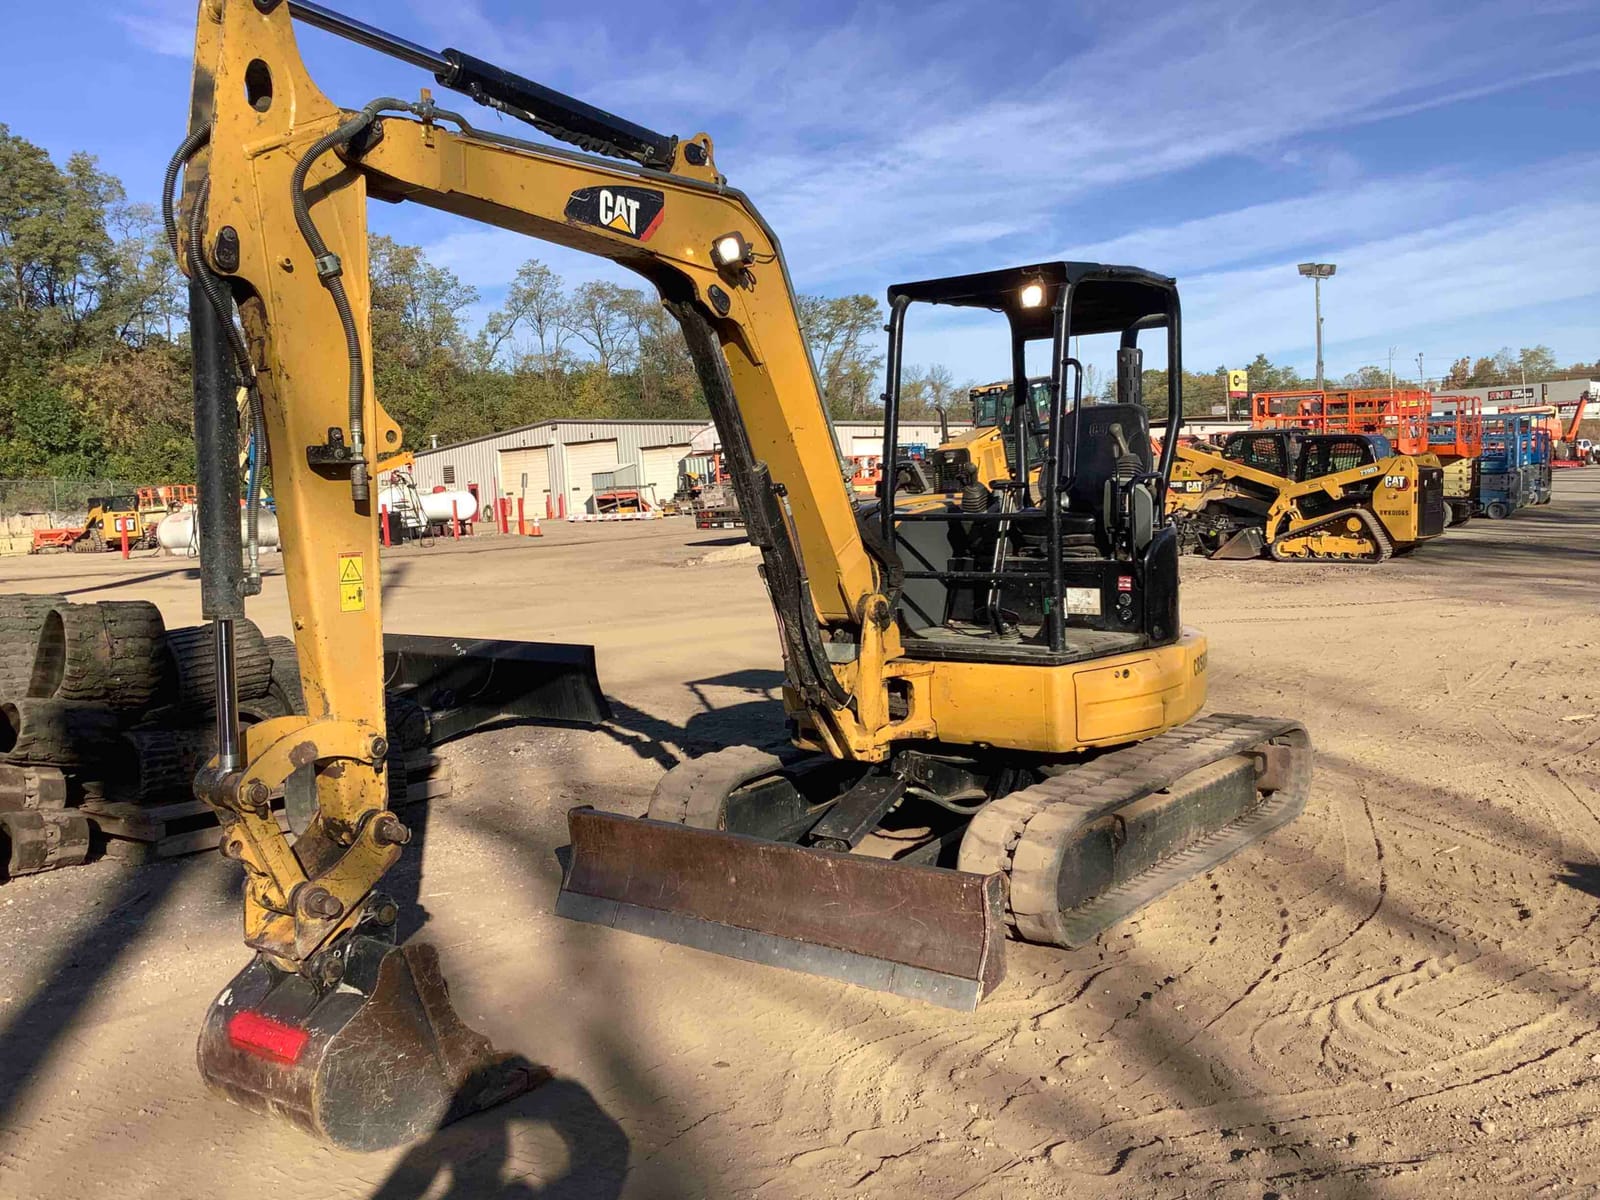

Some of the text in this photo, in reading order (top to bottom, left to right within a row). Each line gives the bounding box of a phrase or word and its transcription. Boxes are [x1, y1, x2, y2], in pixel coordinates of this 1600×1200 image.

[599, 189, 640, 234] CAT
[1186, 481, 1203, 492] CAT
[1385, 476, 1406, 488] CAT
